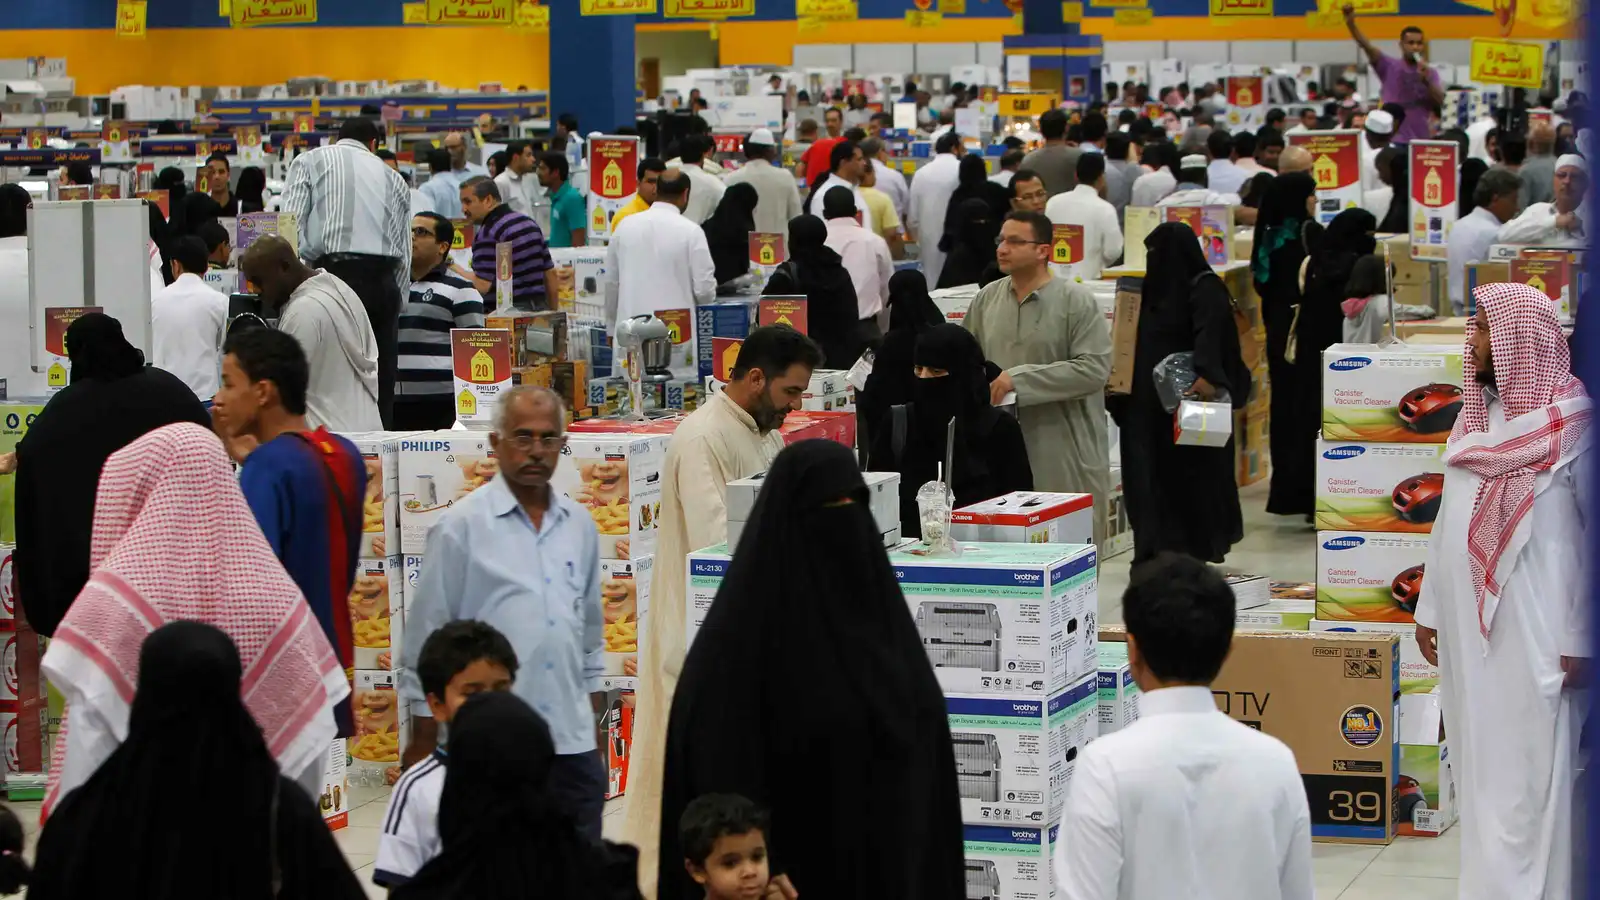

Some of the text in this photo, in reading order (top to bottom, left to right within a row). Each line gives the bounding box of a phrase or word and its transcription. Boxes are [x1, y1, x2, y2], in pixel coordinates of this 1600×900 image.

[605, 174, 617, 190] 20
[1426, 183, 1438, 199] 20
[700, 309, 713, 361] PRINCESS
[475, 364, 488, 377] 20
[1334, 389, 1363, 397] Canister
[1334, 397, 1391, 406] Vacuum Cleaner
[401, 441, 450, 452] PHILIPS
[1327, 477, 1357, 485] Canister
[1327, 486, 1385, 495] Vacuum Cleaner
[1327, 568, 1356, 576] Canister
[1327, 576, 1385, 585] Vacuum Cleaner
[1314, 648, 1339, 656] FRONT
[1400, 662, 1430, 670] Canister
[1013, 704, 1039, 712] brother
[1235, 691, 1270, 716] TV
[1328, 790, 1381, 822] 39
[1011, 830, 1037, 838] brother
